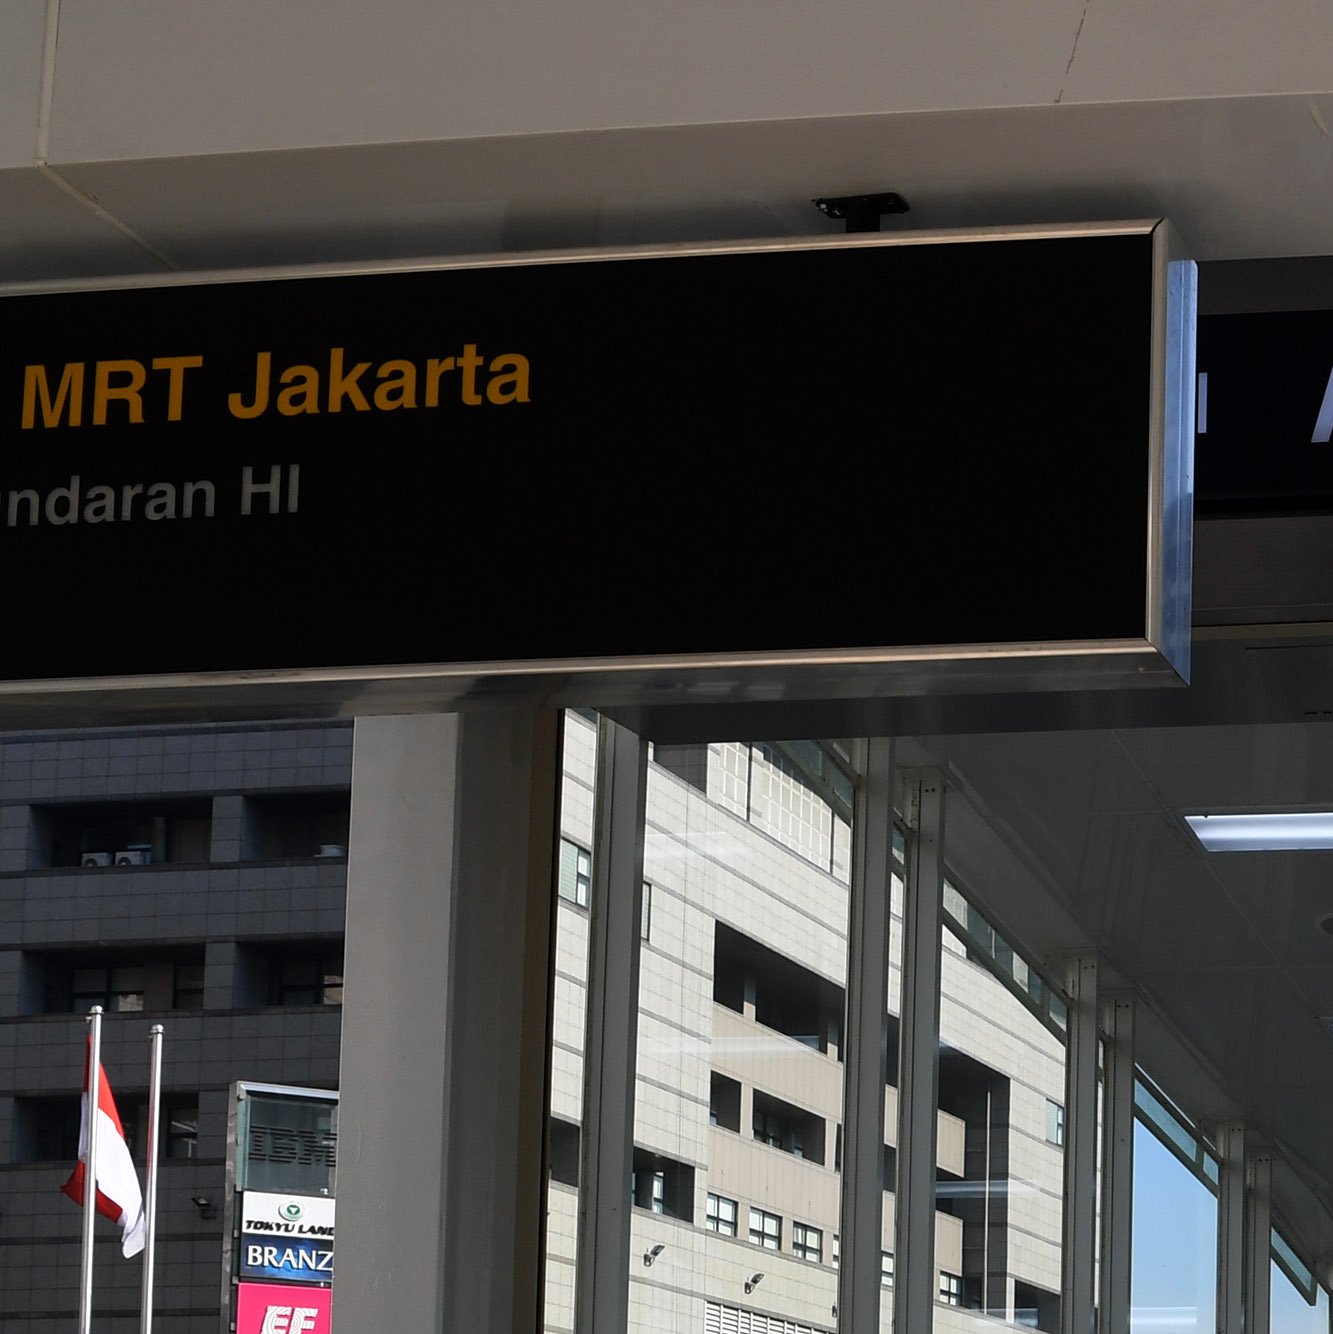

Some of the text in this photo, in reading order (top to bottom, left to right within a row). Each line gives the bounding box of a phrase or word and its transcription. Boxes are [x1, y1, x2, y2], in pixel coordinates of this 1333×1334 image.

[21, 343, 532, 430] MRT Jakarta
[0, 463, 301, 527] ndaran HI
[249, 1126, 337, 1167] IBM
[245, 1219, 295, 1233] TOKYU
[247, 1244, 334, 1272] BRANZ
